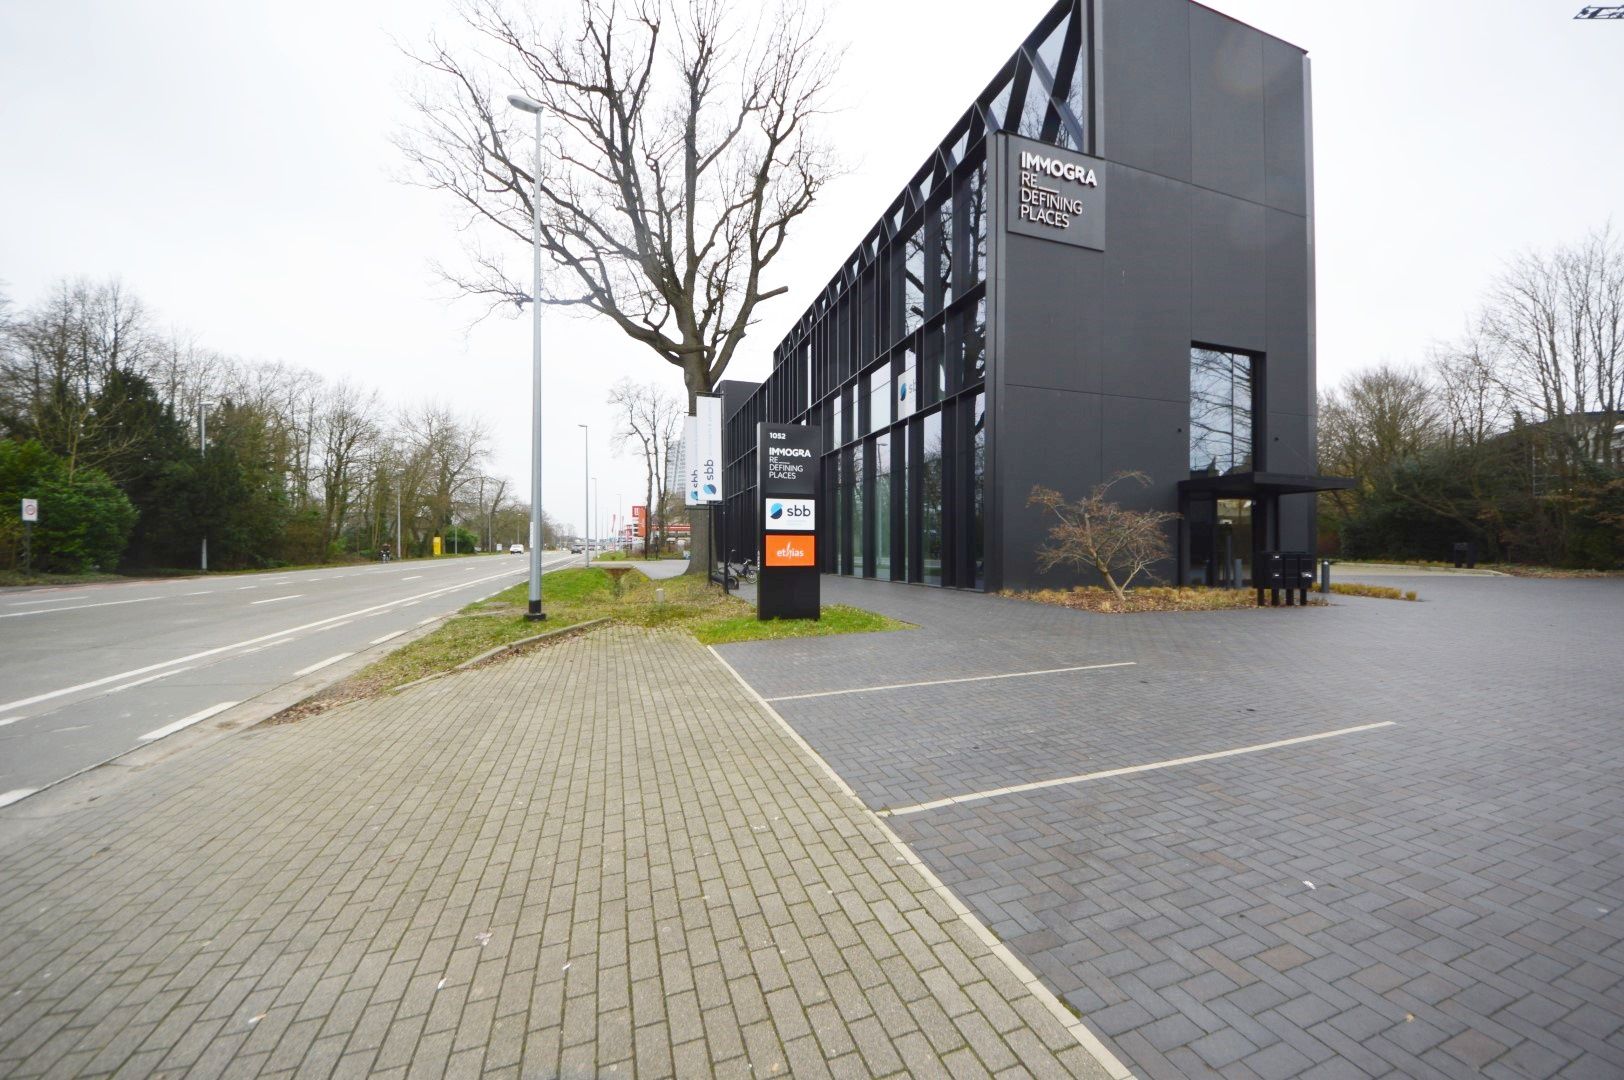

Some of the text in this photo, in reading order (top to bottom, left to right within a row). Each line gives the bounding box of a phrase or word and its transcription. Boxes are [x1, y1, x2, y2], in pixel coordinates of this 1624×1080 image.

[1021, 151, 1097, 186] IMMOGRA
[1021, 188, 1083, 215] DEFINING
[1020, 205, 1070, 228] PLACES
[769, 432, 786, 440] 1052
[769, 446, 811, 458] IMMOGRA
[703, 459, 714, 481] sbb
[769, 463, 804, 472] DEFINING
[768, 471, 797, 480] PLACES
[786, 504, 811, 517] sbb
